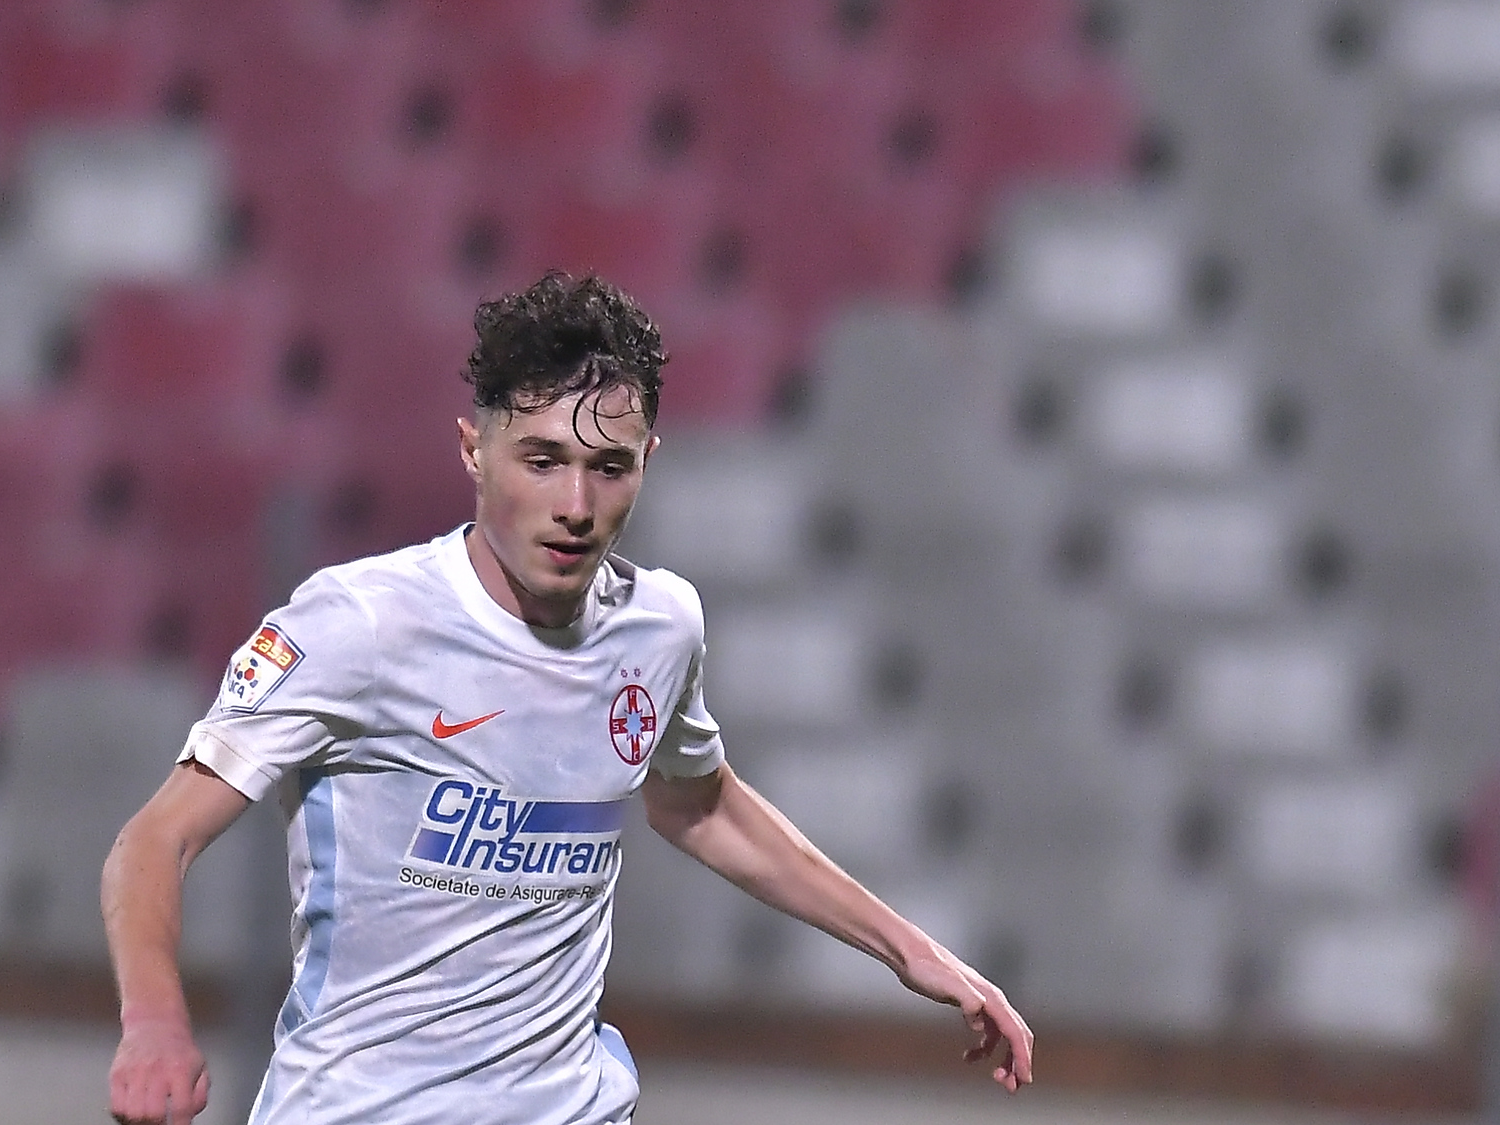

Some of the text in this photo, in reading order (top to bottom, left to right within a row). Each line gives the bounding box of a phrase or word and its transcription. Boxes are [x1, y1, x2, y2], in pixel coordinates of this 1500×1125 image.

[426, 780, 535, 845] City
[446, 826, 619, 875] Insuran
[399, 867, 480, 896] Societate
[485, 884, 506, 899] de
